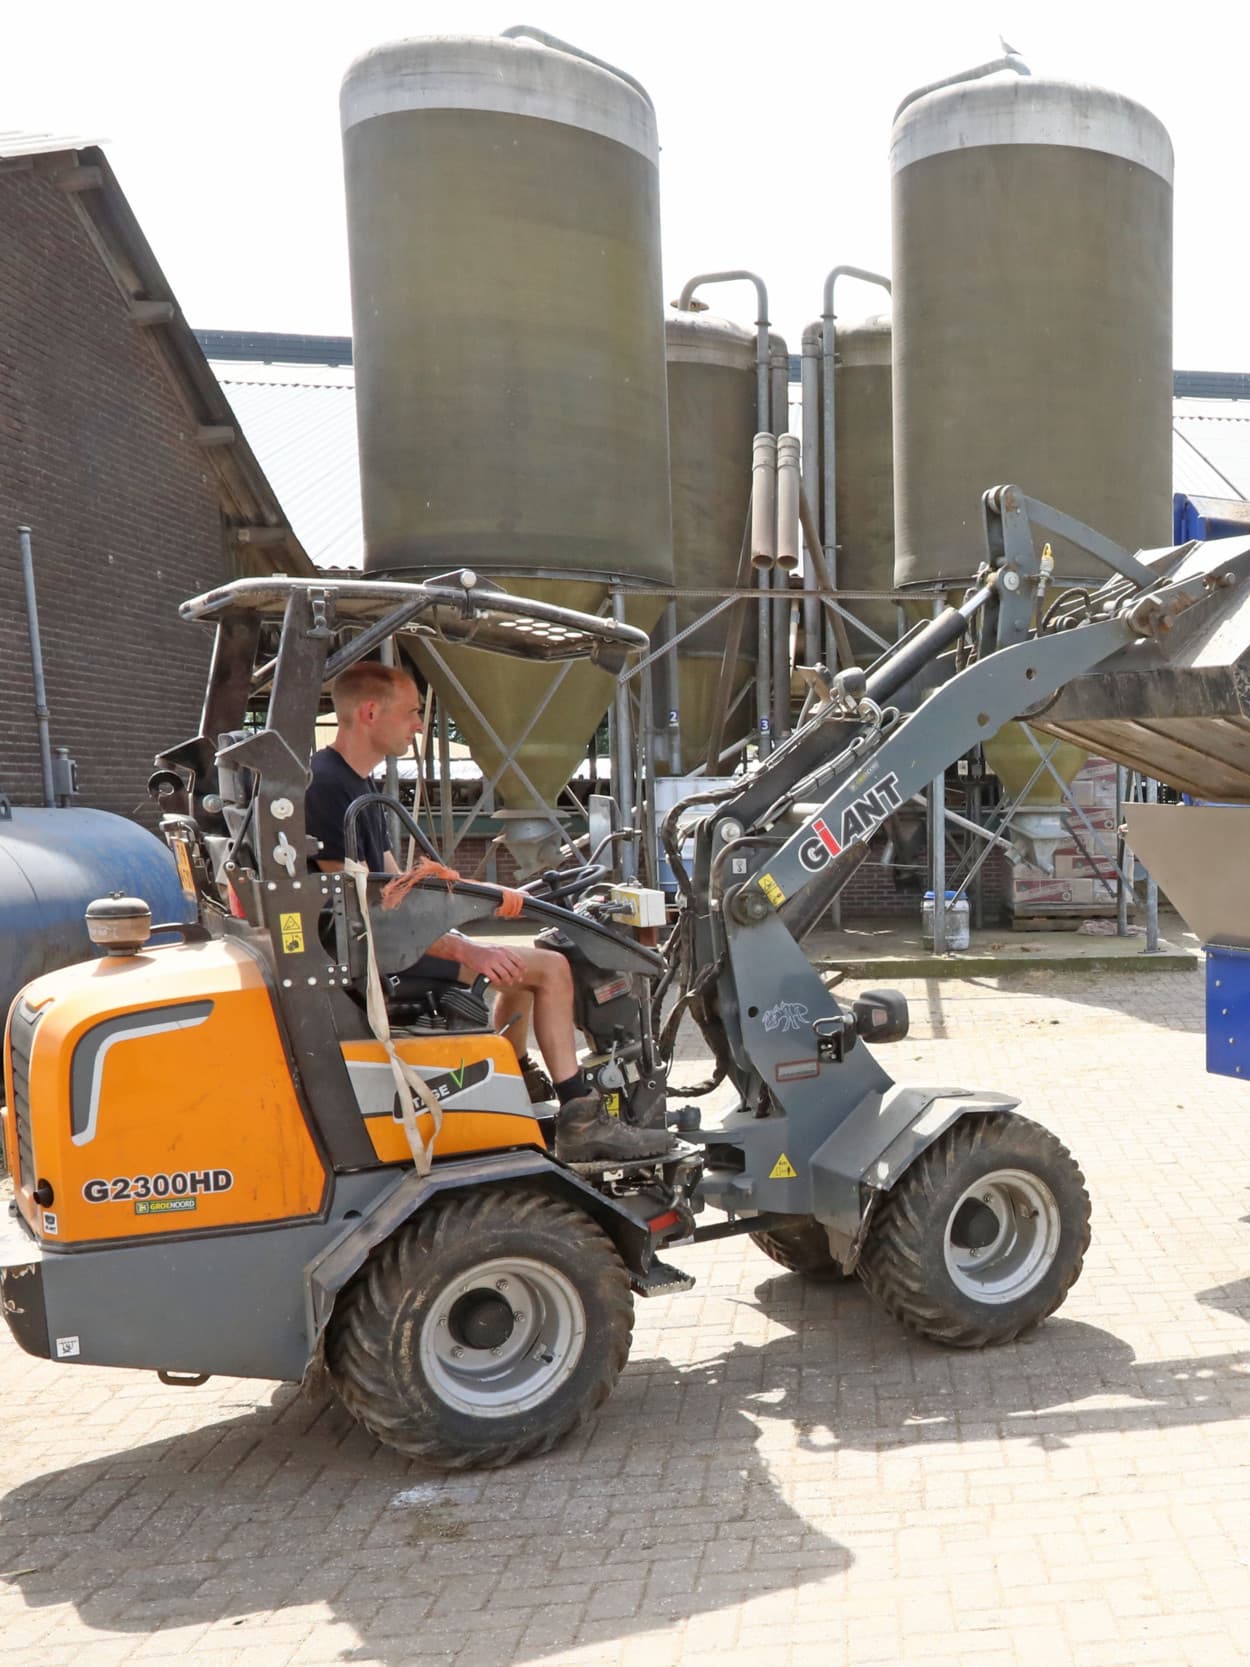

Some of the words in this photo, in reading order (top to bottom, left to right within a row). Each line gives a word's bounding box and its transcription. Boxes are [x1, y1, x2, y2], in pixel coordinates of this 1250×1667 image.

[669, 711, 678, 722] 2
[761, 720, 769, 730] 3
[82, 1168, 234, 1204] G2300HD
